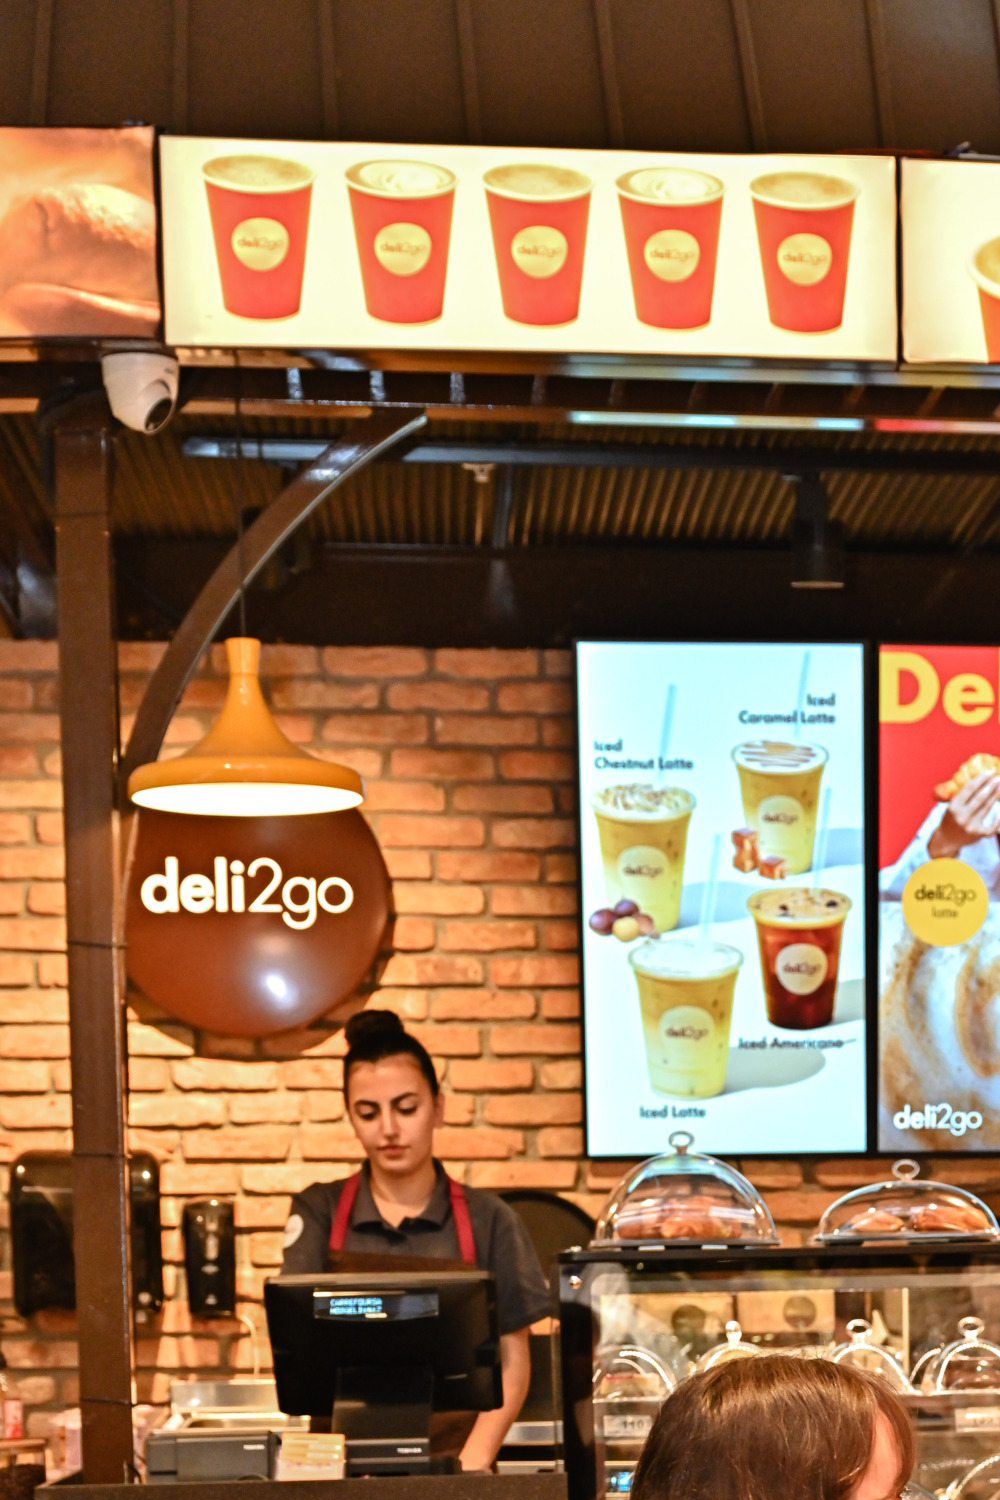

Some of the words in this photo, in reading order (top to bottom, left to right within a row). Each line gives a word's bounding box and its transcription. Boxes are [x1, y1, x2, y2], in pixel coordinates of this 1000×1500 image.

[806, 693, 836, 707] Iced
[738, 710, 798, 724] Caramel
[801, 711, 835, 724] Latte
[594, 739, 622, 751] Iced
[594, 757, 654, 769] Chestnut
[659, 757, 693, 769] Latte
[140, 856, 354, 930] deli2go
[914, 883, 977, 906] deli2go
[739, 1037, 767, 1050] Iced
[640, 1105, 668, 1118] Iced
[672, 1105, 706, 1118] Latte
[893, 1102, 983, 1137] deli2go
